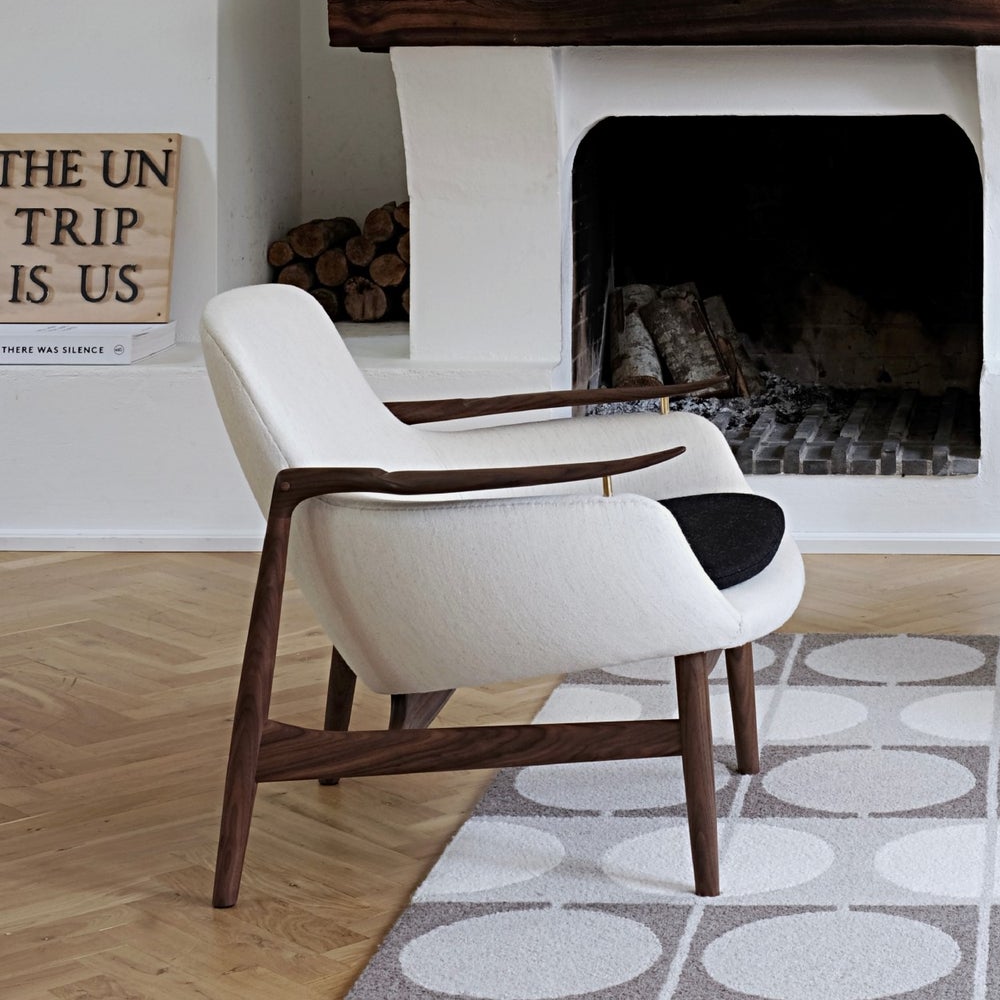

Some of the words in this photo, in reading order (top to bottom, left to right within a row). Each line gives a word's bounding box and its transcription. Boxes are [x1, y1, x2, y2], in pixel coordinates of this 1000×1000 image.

[0, 150, 82, 187] THE
[101, 150, 173, 187] UN
[15, 207, 138, 245] TRIP
[9, 264, 48, 303] IS
[78, 264, 138, 303] US
[2, 346, 34, 354] THERE
[37, 346, 59, 354] WAS
[62, 346, 104, 354] SILENCE
